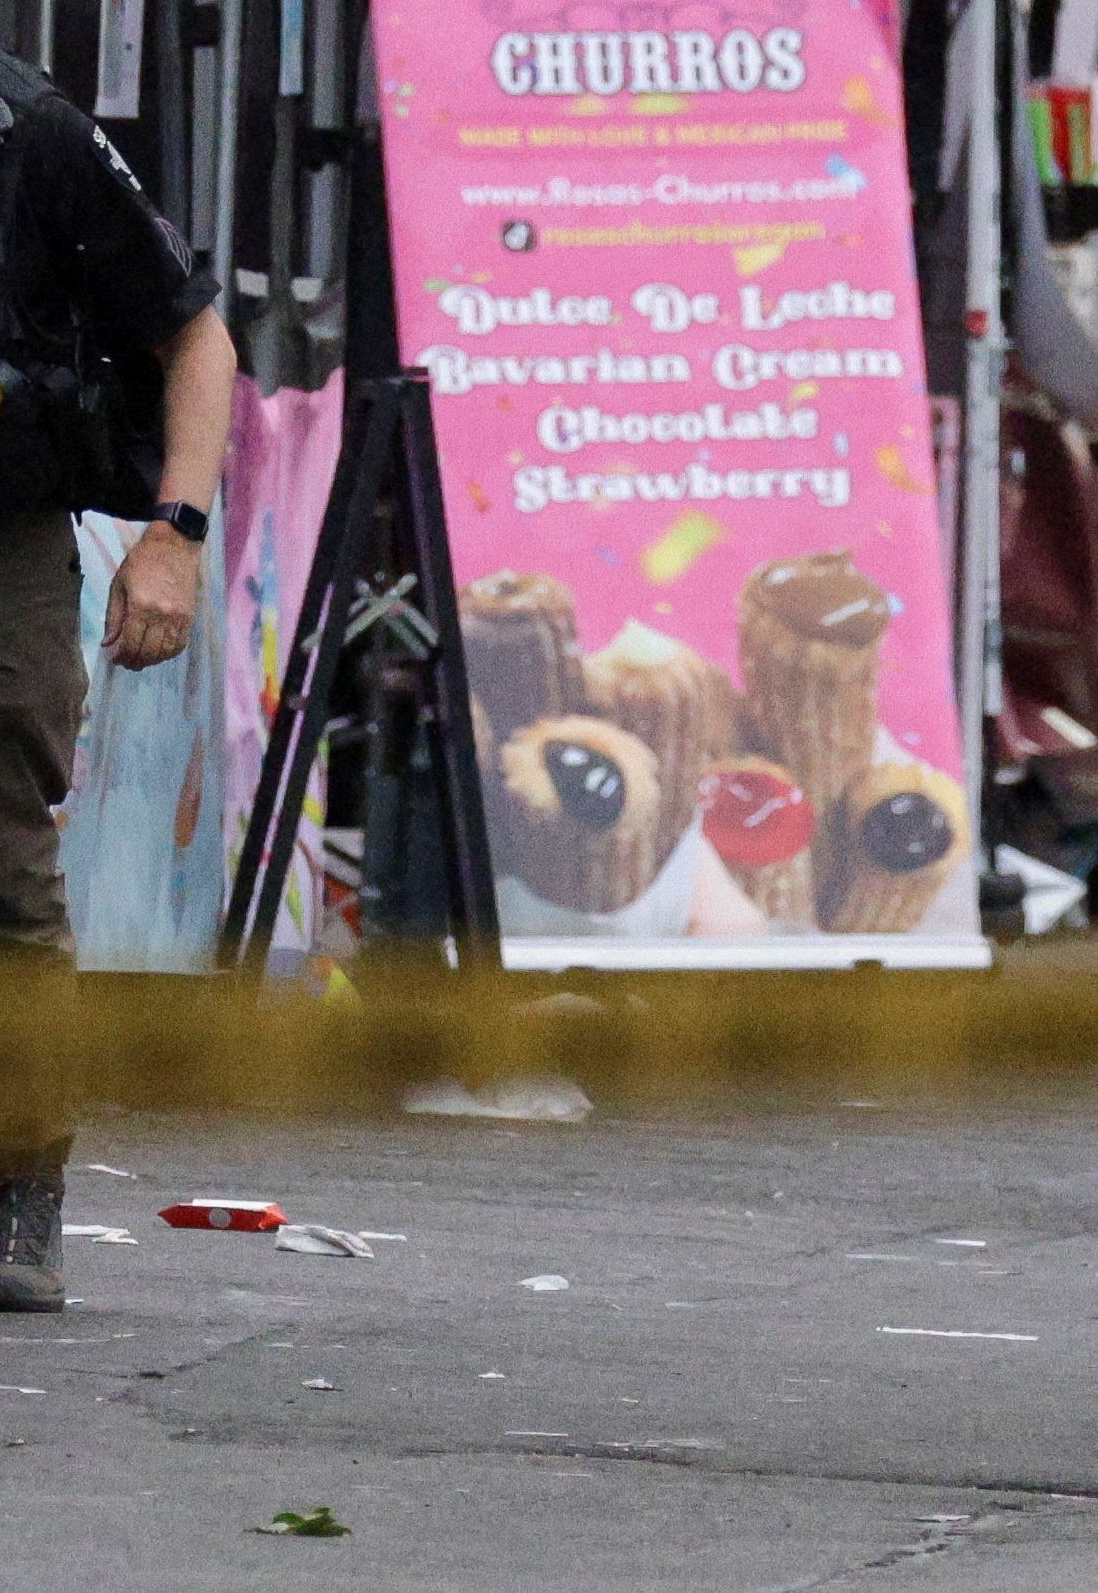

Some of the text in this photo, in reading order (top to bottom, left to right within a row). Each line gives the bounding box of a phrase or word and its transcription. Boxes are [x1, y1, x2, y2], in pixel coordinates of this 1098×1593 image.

[491, 27, 806, 96] CHURROS
[438, 280, 896, 335] Dulce De Leche
[415, 343, 903, 395] Bavarian Cream
[536, 403, 819, 453] Chocolate
[513, 463, 851, 513] Strawberry
